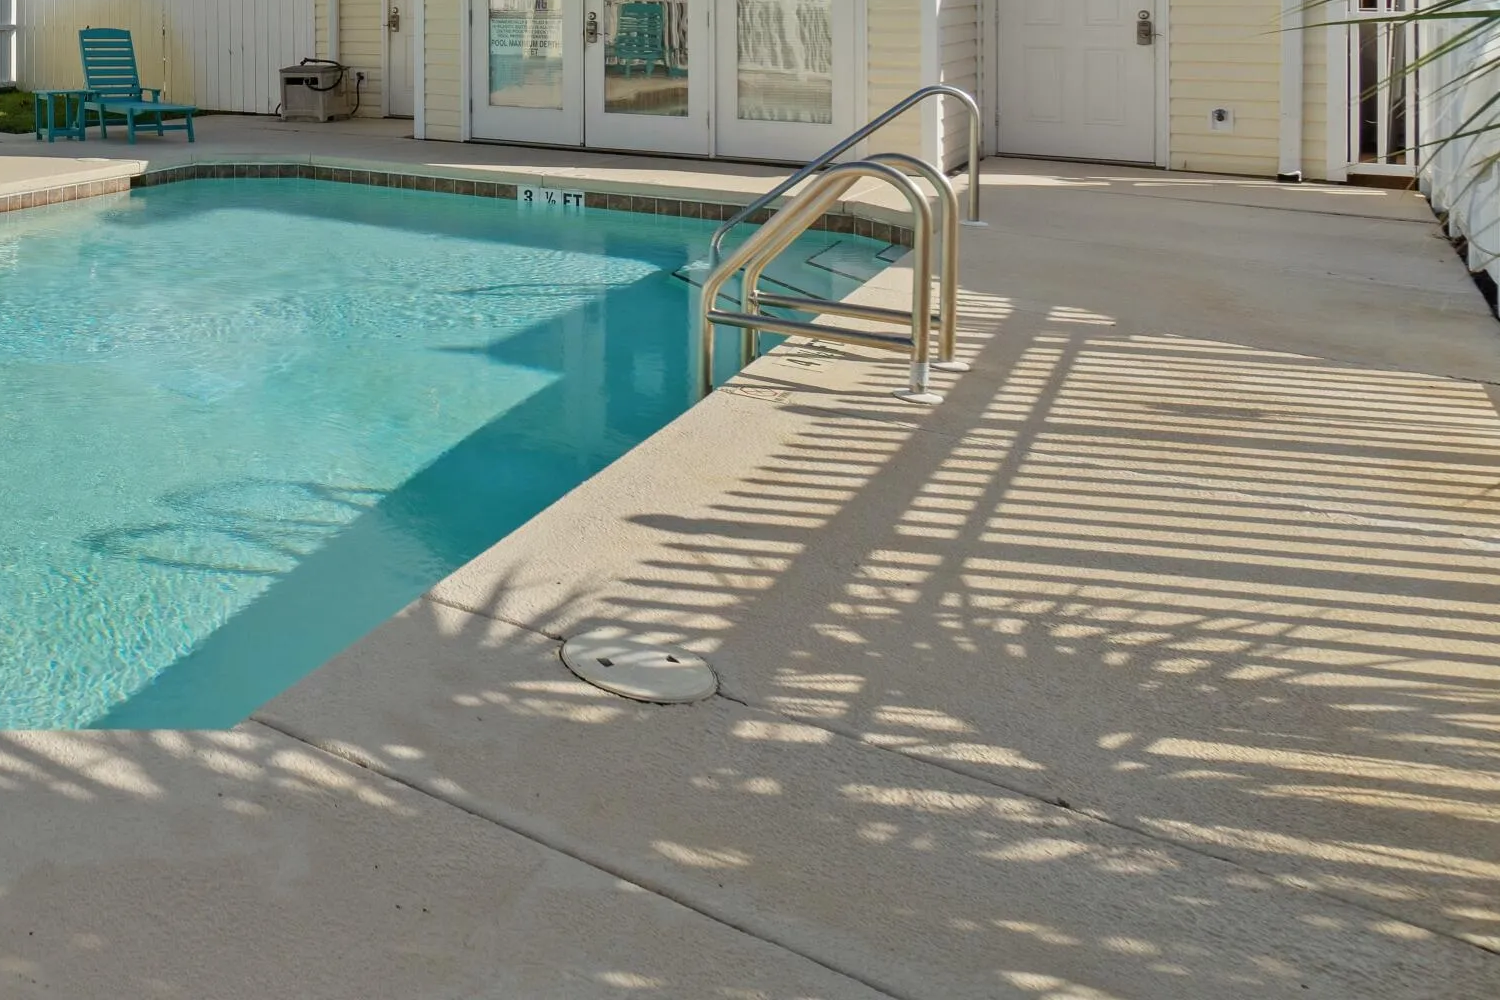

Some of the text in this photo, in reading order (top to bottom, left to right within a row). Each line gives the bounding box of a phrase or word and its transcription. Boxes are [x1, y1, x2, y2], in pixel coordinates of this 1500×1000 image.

[491, 39, 507, 47] POOL
[524, 189, 533, 202] 3
[563, 192, 582, 207] FT
